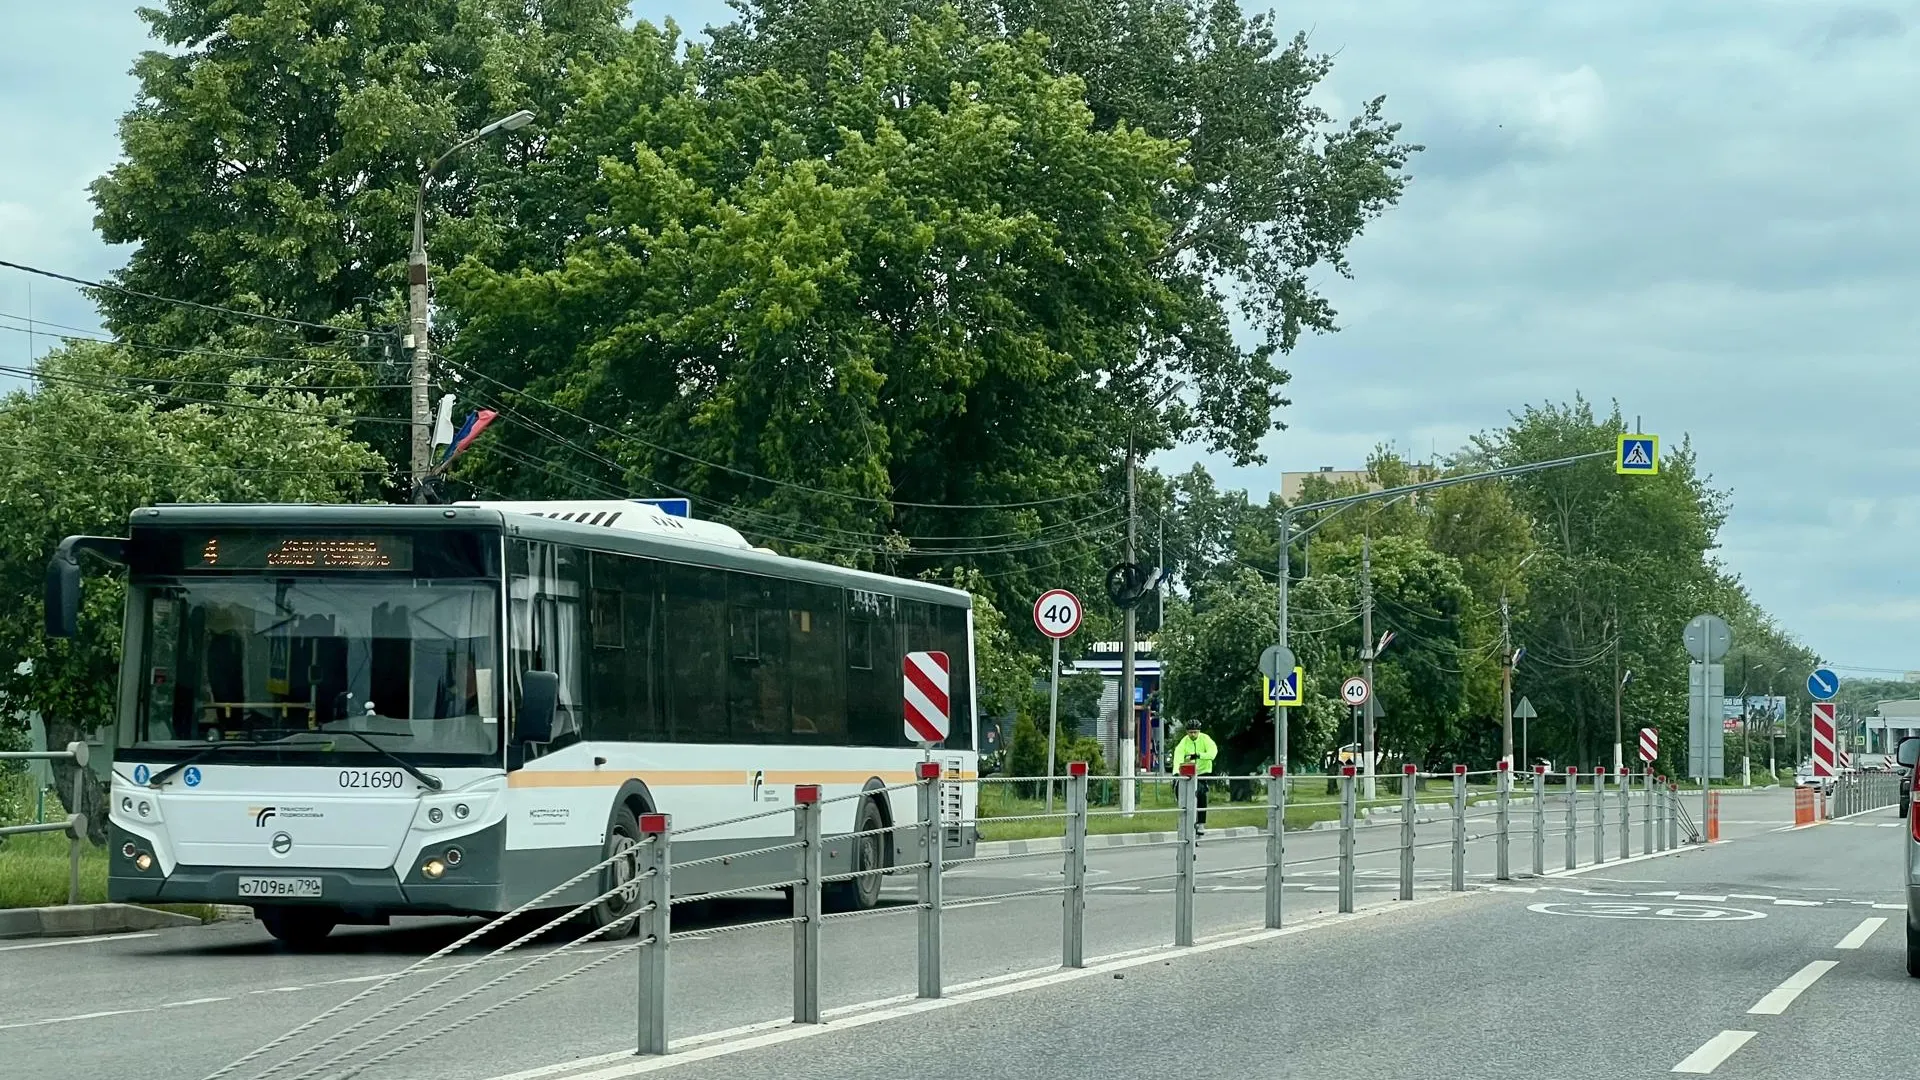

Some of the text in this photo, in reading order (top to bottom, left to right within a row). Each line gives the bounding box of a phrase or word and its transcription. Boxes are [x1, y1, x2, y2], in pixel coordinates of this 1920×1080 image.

[1044, 605, 1071, 624] 40
[1347, 686, 1364, 697] 40
[338, 770, 403, 789] 021690
[242, 880, 318, 894] О709ВА 790
